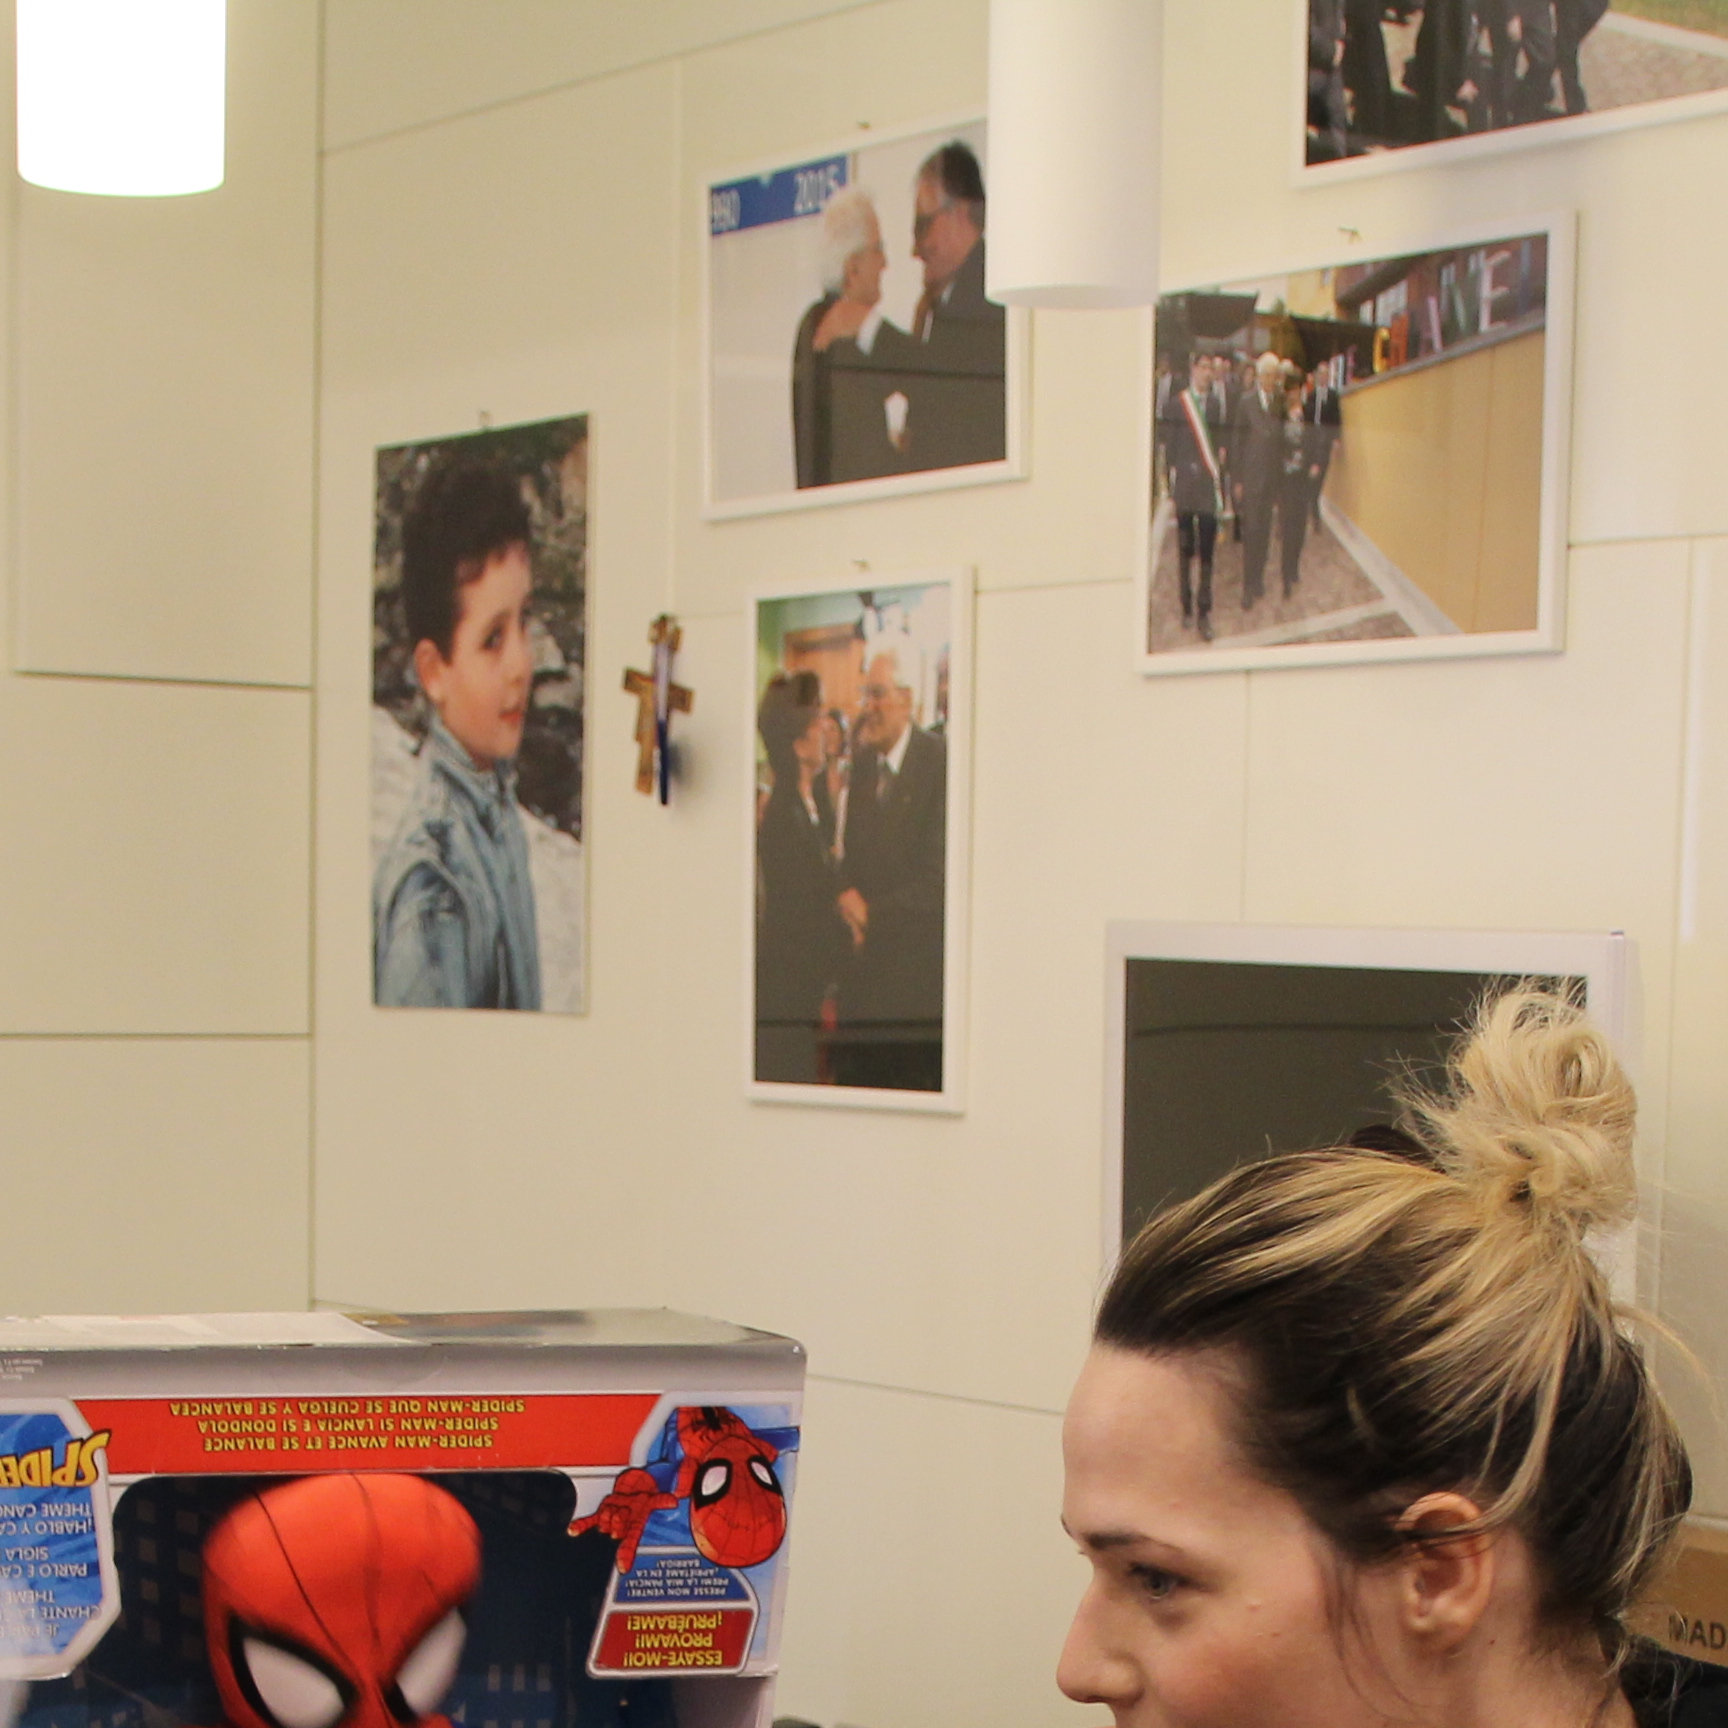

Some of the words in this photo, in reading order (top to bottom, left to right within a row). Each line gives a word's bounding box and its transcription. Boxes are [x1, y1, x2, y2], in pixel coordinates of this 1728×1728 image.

[169, 1402, 253, 1416] BALANCEA
[259, 1402, 277, 1414] SE
[283, 1402, 292, 1414] Y
[298, 1401, 359, 1414] CUELGA
[366, 1401, 383, 1413] SE
[390, 1400, 421, 1412] QUE
[428, 1399, 525, 1412] SPIDER-MAN
[198, 1419, 276, 1433] DONDOLA
[282, 1419, 297, 1432] SI
[303, 1419, 311, 1431] E
[317, 1418, 374, 1431] LANCIA
[380, 1418, 394, 1430] SI
[400, 1417, 499, 1430] SPIDER-MAN
[205, 1437, 275, 1451] BALANCE
[282, 1437, 299, 1449] SE
[306, 1436, 322, 1449] ET
[329, 1436, 389, 1448] AVANCE
[395, 1434, 493, 1448] SPIDER-MAN
[41, 1503, 91, 1518] THEME
[21, 1522, 30, 1534] Y
[5, 1547, 48, 1560] SIGLA
[27, 1566, 34, 1577] E
[39, 1562, 87, 1577] PARLO
[650, 1569, 662, 1577] EN
[41, 1605, 100, 1618] CHANTE
[635, 1633, 713, 1648] PROVAMI!
[623, 1650, 723, 1666] ESSAYE-MOI!
